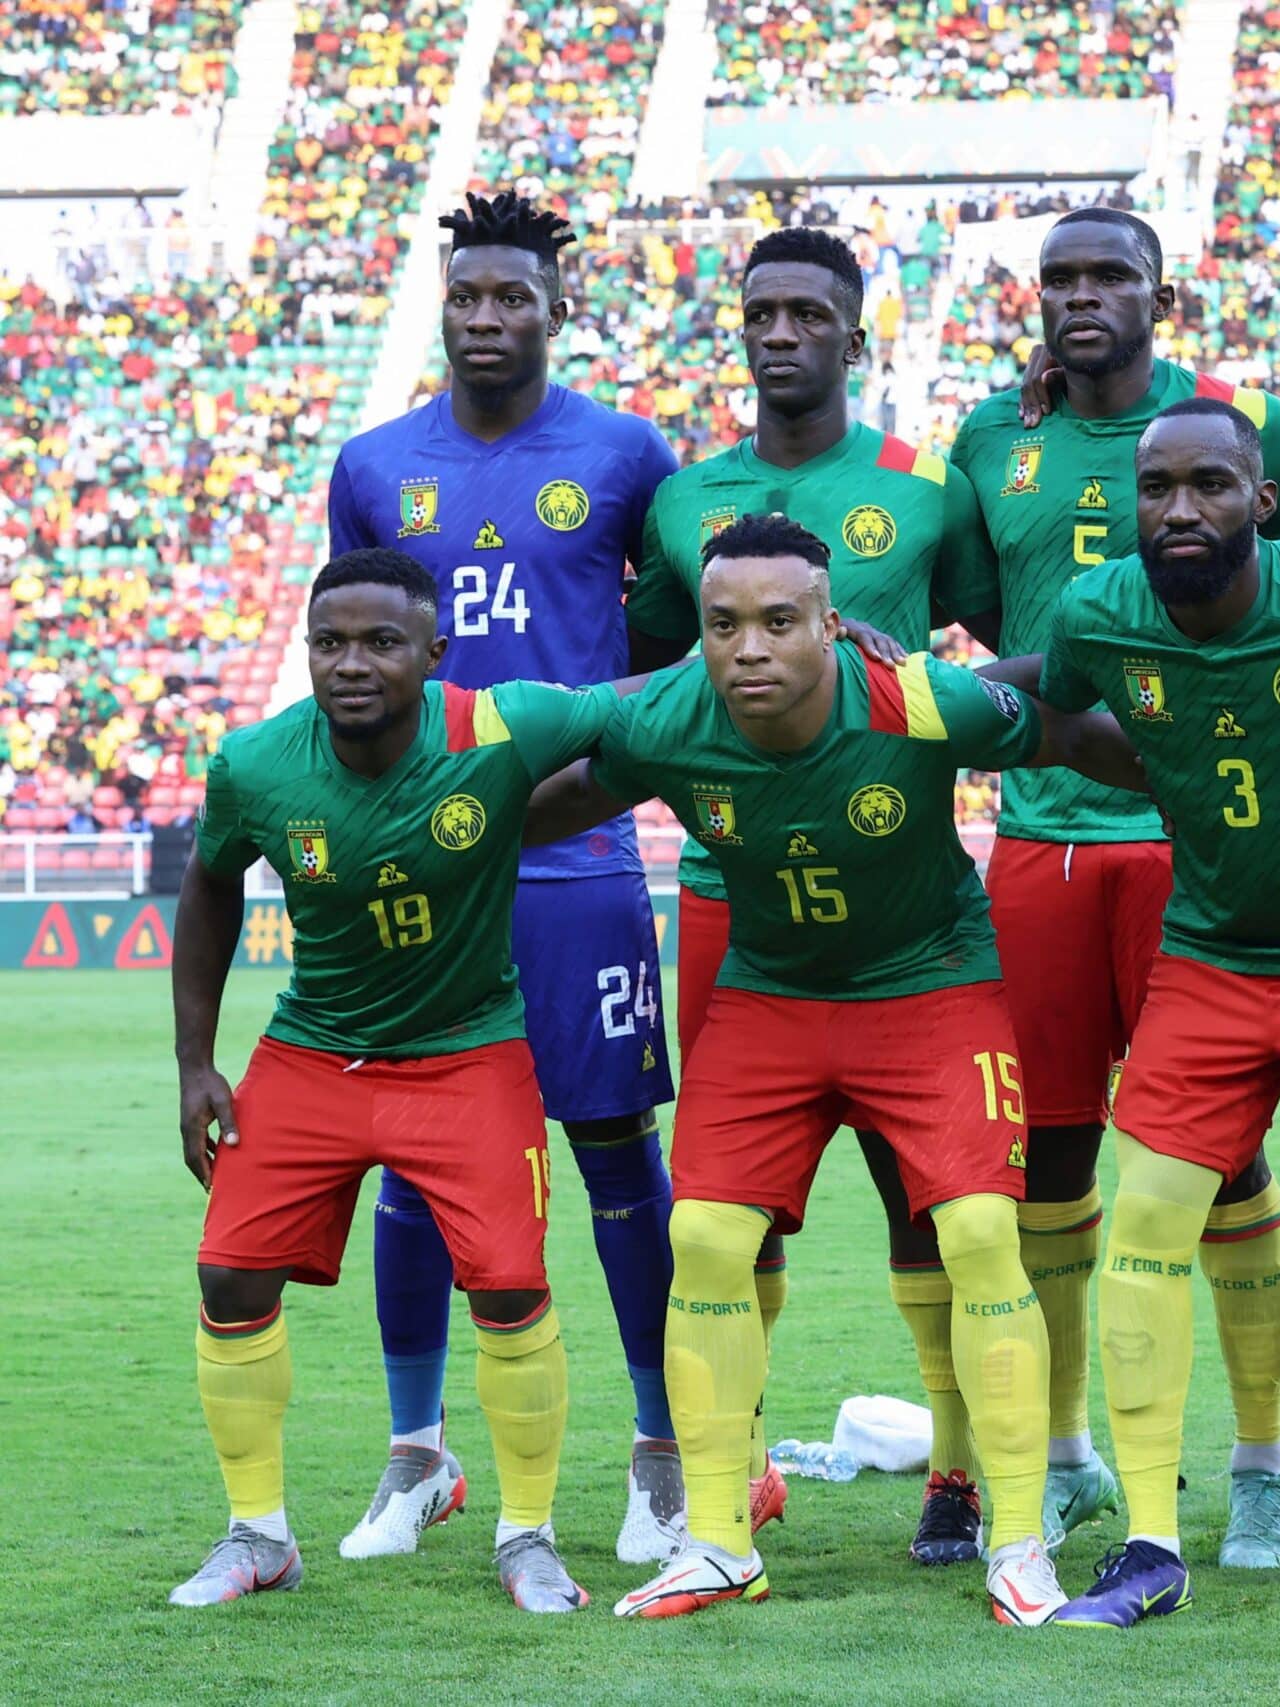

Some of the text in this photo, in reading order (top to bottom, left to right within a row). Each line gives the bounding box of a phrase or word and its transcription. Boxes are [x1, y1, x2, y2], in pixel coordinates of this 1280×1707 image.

[1072, 525, 1108, 581] 5
[452, 562, 531, 637] 24
[1216, 758, 1261, 828] 3
[367, 893, 433, 950] 19
[776, 867, 849, 924] 15
[597, 960, 658, 1040] 24
[973, 1050, 1025, 1125] 15
[1031, 1257, 1097, 1281] SPORTIF
[1112, 1256, 1192, 1277] LE COQ SPO
[1210, 1274, 1221, 1288] LE
[1223, 1280, 1256, 1290] COQ
[689, 1301, 751, 1315] SPORTIF
[965, 1301, 978, 1316] LE
[981, 1302, 1014, 1317] COQ
